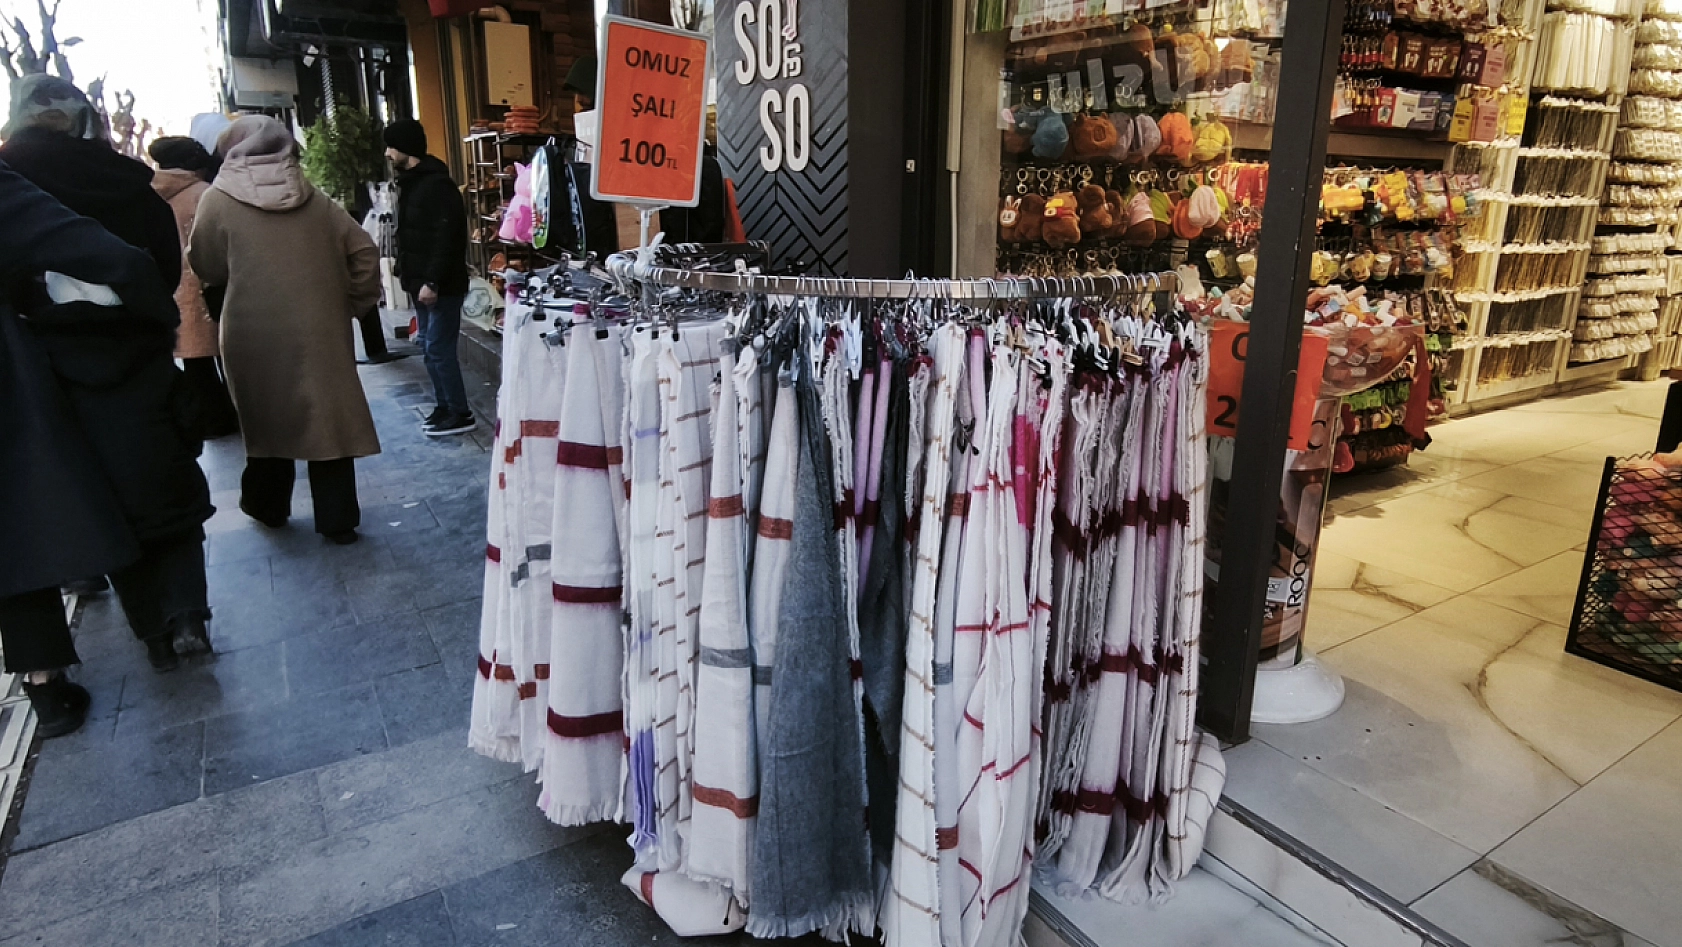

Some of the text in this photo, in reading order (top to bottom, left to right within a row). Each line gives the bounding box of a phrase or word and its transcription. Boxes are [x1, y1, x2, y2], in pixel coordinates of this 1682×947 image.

[625, 46, 691, 78] OMUZ
[734, 0, 781, 85] SO
[631, 93, 677, 120] ŞALI
[760, 83, 810, 172] SO
